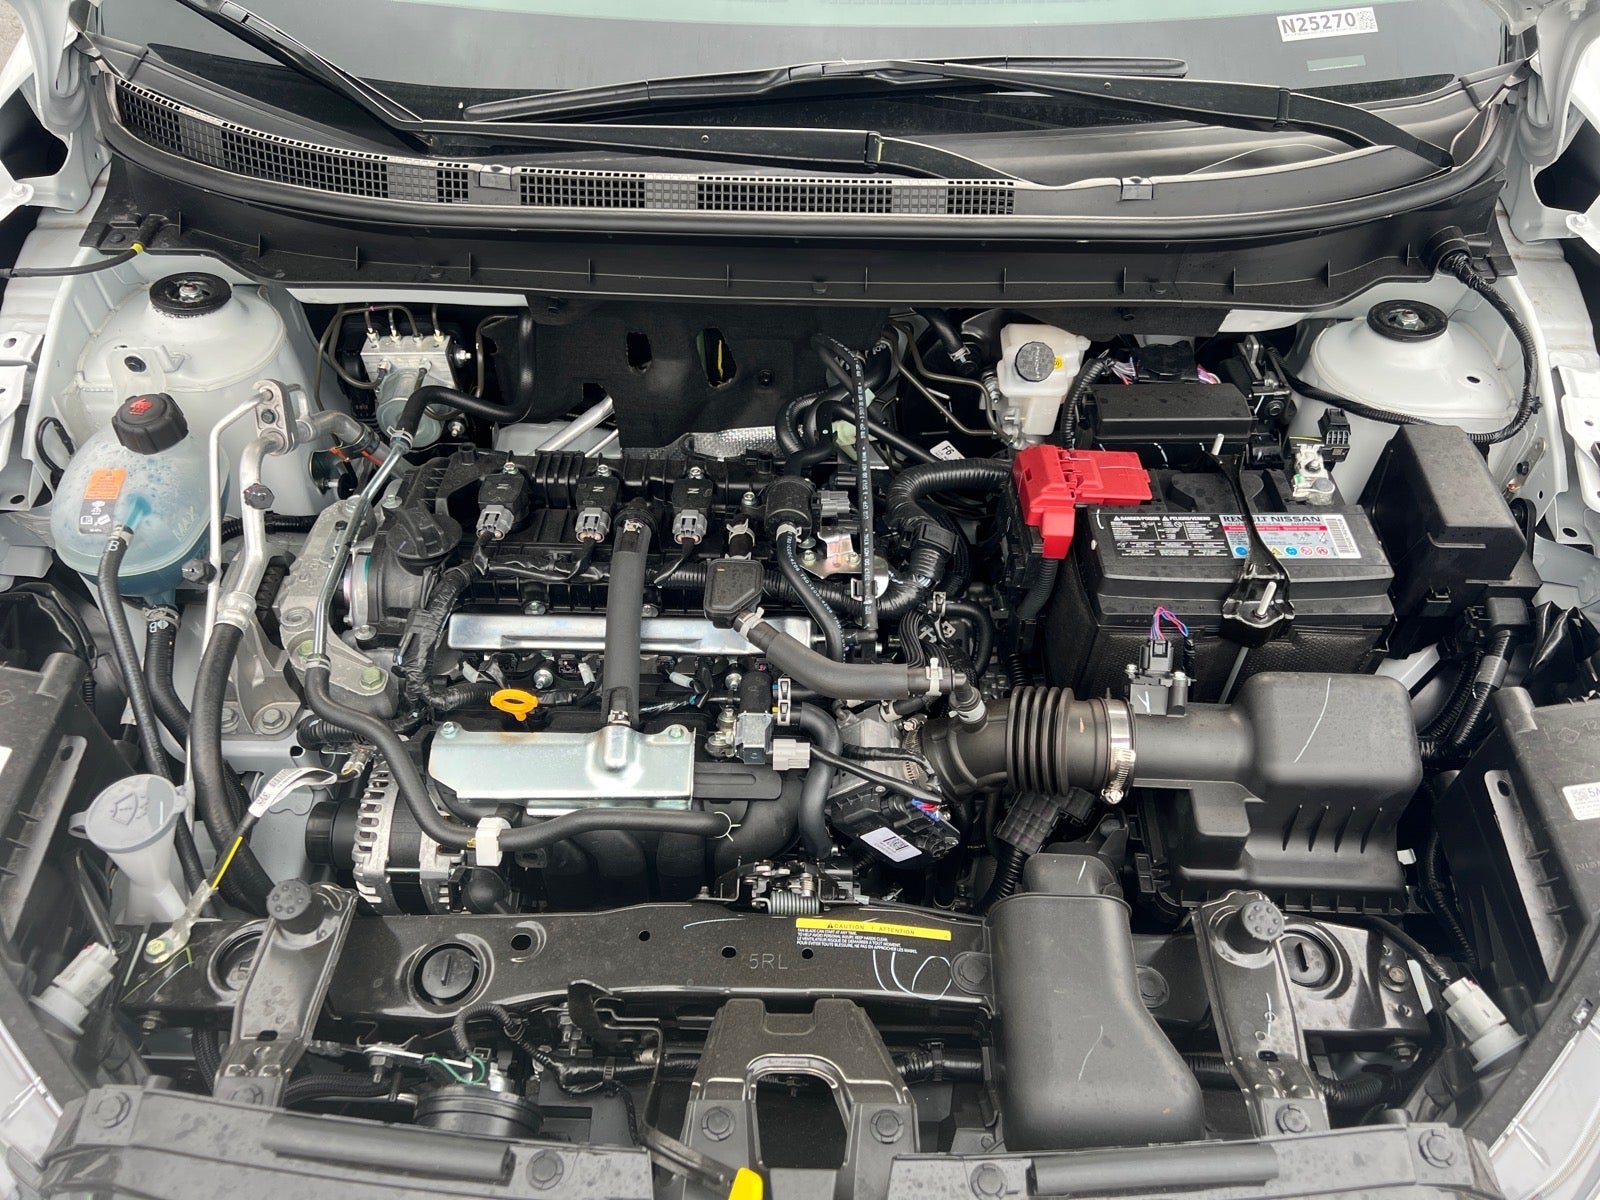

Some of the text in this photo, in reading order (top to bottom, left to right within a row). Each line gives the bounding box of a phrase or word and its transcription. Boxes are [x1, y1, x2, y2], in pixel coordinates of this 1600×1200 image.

[1281, 12, 1356, 34] N25270
[942, 445, 955, 456] F6
[109, 540, 120, 552] B
[750, 953, 788, 970] 5RL
